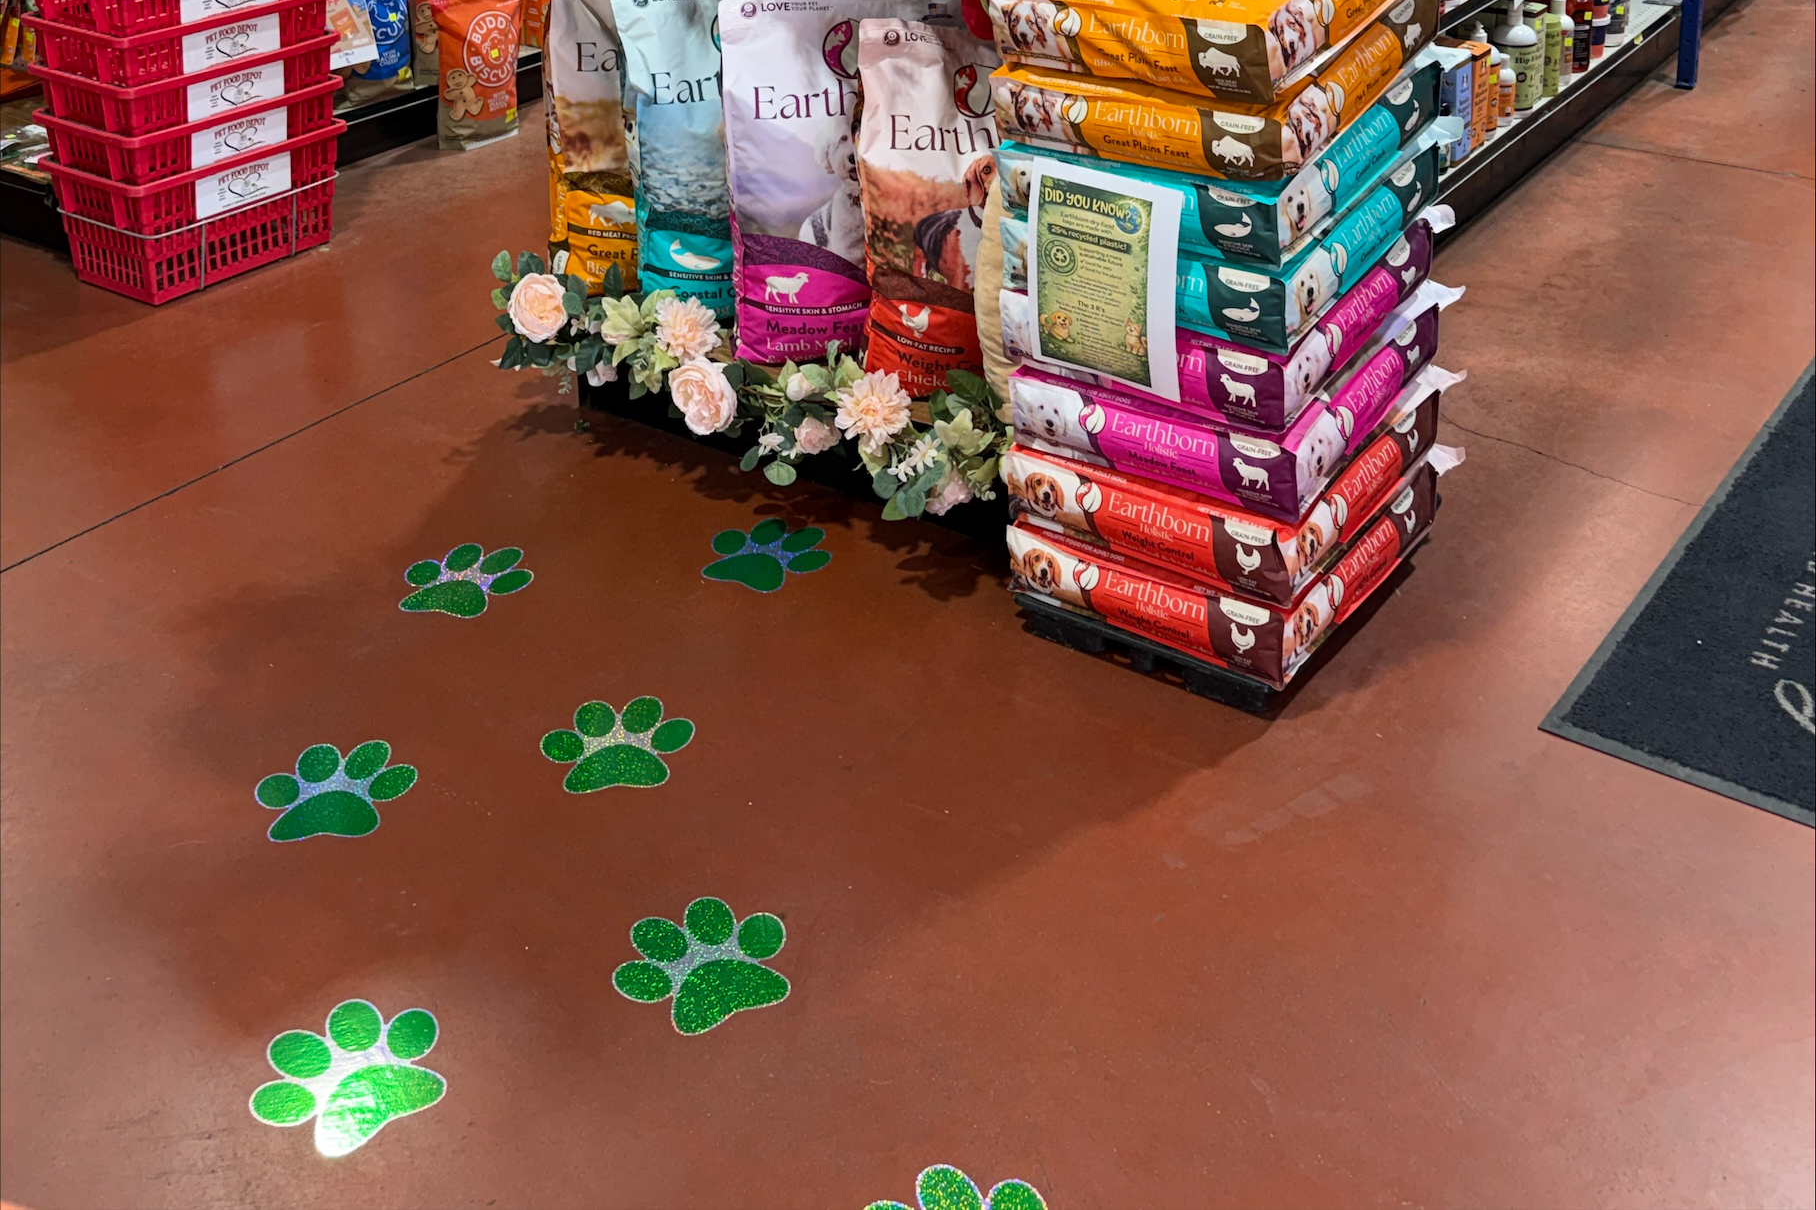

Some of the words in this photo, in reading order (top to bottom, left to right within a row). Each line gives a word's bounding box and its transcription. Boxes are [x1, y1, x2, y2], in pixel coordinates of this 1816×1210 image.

[761, 2, 790, 12] LOVE
[1089, 14, 1185, 50] Earthborn
[1203, 32, 1239, 42] GRAIN-FREE
[1094, 101, 1199, 136] Earthborn
[1219, 121, 1257, 132] GRAIN-FREE
[1103, 135, 1131, 149] Great
[1133, 141, 1161, 153] Plains
[1333, 109, 1392, 170] Earthborn
[217, 174, 229, 186] PET
[231, 168, 248, 179] FOOD
[249, 163, 269, 174] DEPOT
[1044, 188, 1064, 203] DID
[1066, 192, 1090, 210] YOU
[1093, 198, 1132, 222] KNOW?
[1217, 194, 1251, 205] GRAIN-FREE
[1060, 211, 1089, 224] Earthborn
[1090, 219, 1101, 229] dry
[1102, 220, 1114, 229] food
[1051, 225, 1067, 236] 25%
[1068, 229, 1098, 243] recycled
[1100, 237, 1127, 250] plastic!
[587, 244, 628, 260] Great
[669, 272, 702, 280] SENSITIVE
[1225, 278, 1261, 291] GRAIN-FREE
[765, 304, 800, 314] SENSITIVE
[802, 305, 822, 314] SKIN
[829, 301, 863, 312] STOMACH
[1336, 273, 1391, 327] Earthborn
[766, 320, 828, 336] Meadow
[766, 336, 811, 353] Lamb
[899, 351, 955, 374] Weight
[1223, 359, 1260, 374] GRAIN-FREE
[1111, 411, 1215, 457] Earthborn
[1143, 441, 1178, 459] Holistic
[1236, 444, 1273, 457] GRAIN-FREE
[1128, 450, 1166, 469] Meadow
[1340, 440, 1397, 502] Earthborn
[1107, 492, 1210, 542] Earthborn
[1139, 523, 1174, 541] Holistic
[1230, 530, 1267, 544] GRAIN-FREE
[1121, 530, 1154, 550] Weight
[1157, 542, 1194, 561] Control
[1340, 521, 1394, 582] Earthborn
[1105, 570, 1205, 621] Earthborn
[1135, 600, 1169, 619] Holistic
[1225, 609, 1261, 625] GRAIN-FREE
[1118, 607, 1150, 627] Weight
[1154, 620, 1190, 639] Control
